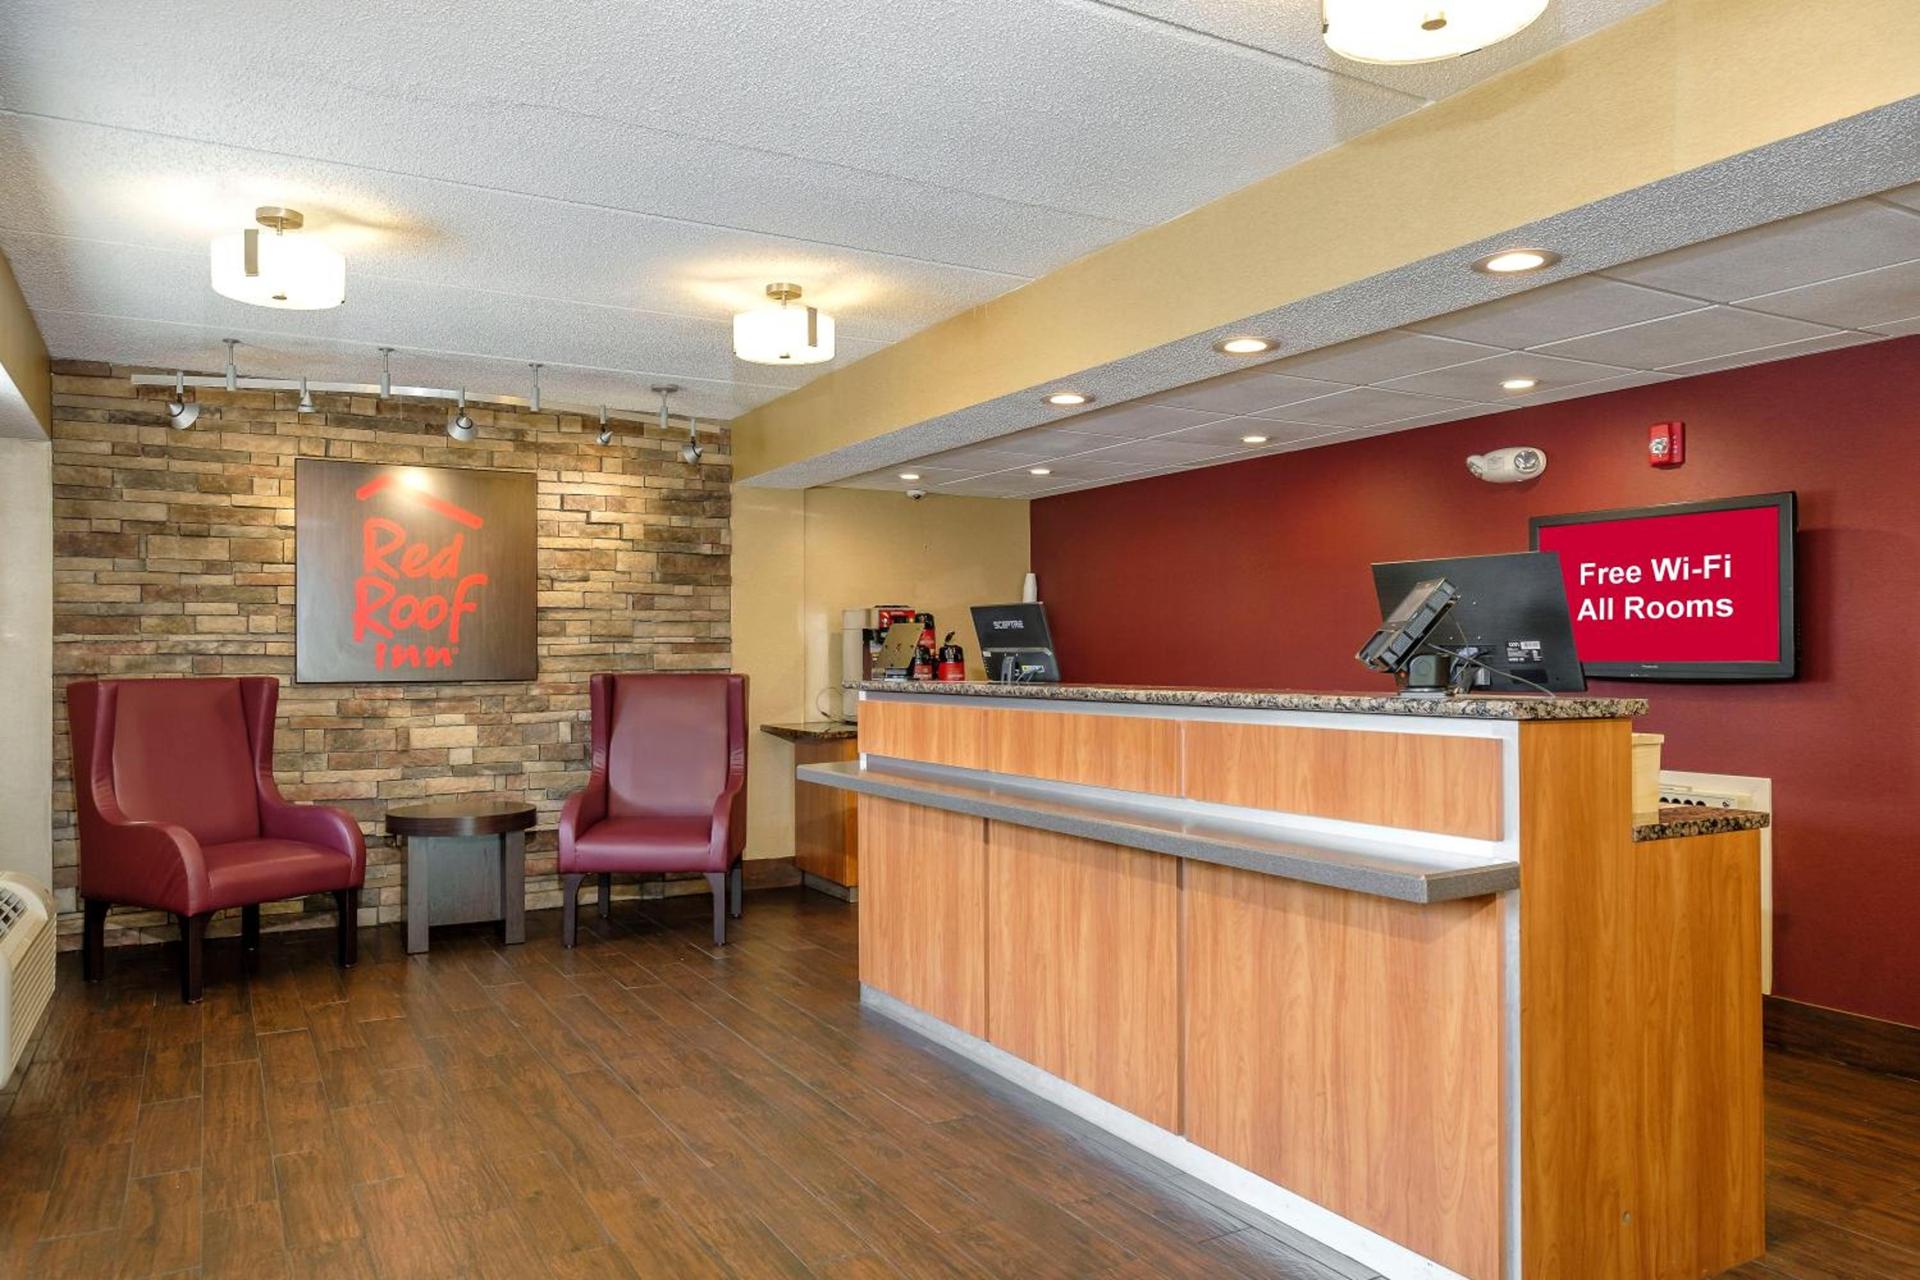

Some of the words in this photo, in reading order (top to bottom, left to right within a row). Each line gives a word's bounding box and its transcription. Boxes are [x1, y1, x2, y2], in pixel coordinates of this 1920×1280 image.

[364, 518, 465, 579] Red
[1579, 562, 1642, 586] Free
[1651, 553, 1732, 582] Wi-Fi
[353, 573, 488, 643] Roof
[1577, 597, 1614, 621] All
[1624, 596, 1734, 620] Rooms
